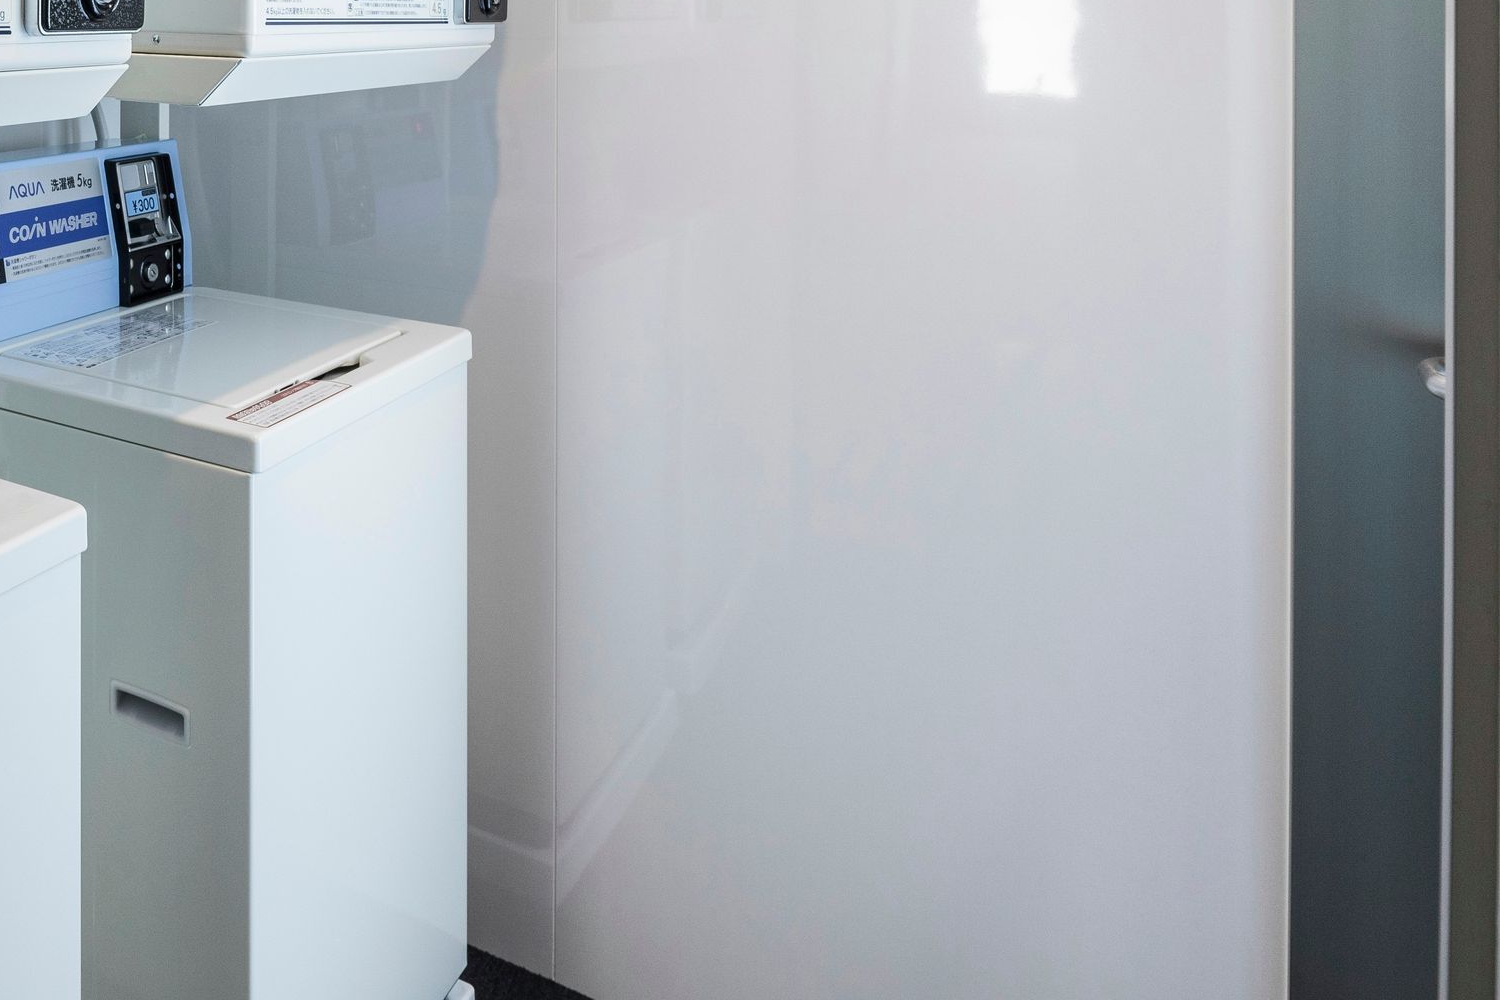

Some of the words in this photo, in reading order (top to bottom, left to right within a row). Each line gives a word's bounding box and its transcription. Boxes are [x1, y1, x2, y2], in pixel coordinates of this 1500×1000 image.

[9, 181, 45, 200] AQUA
[51, 177, 75, 192] 洗濯機
[77, 173, 92, 188] 5kg
[132, 197, 155, 213] ¥300
[9, 216, 46, 243] COIN
[49, 212, 98, 235] WASHER
